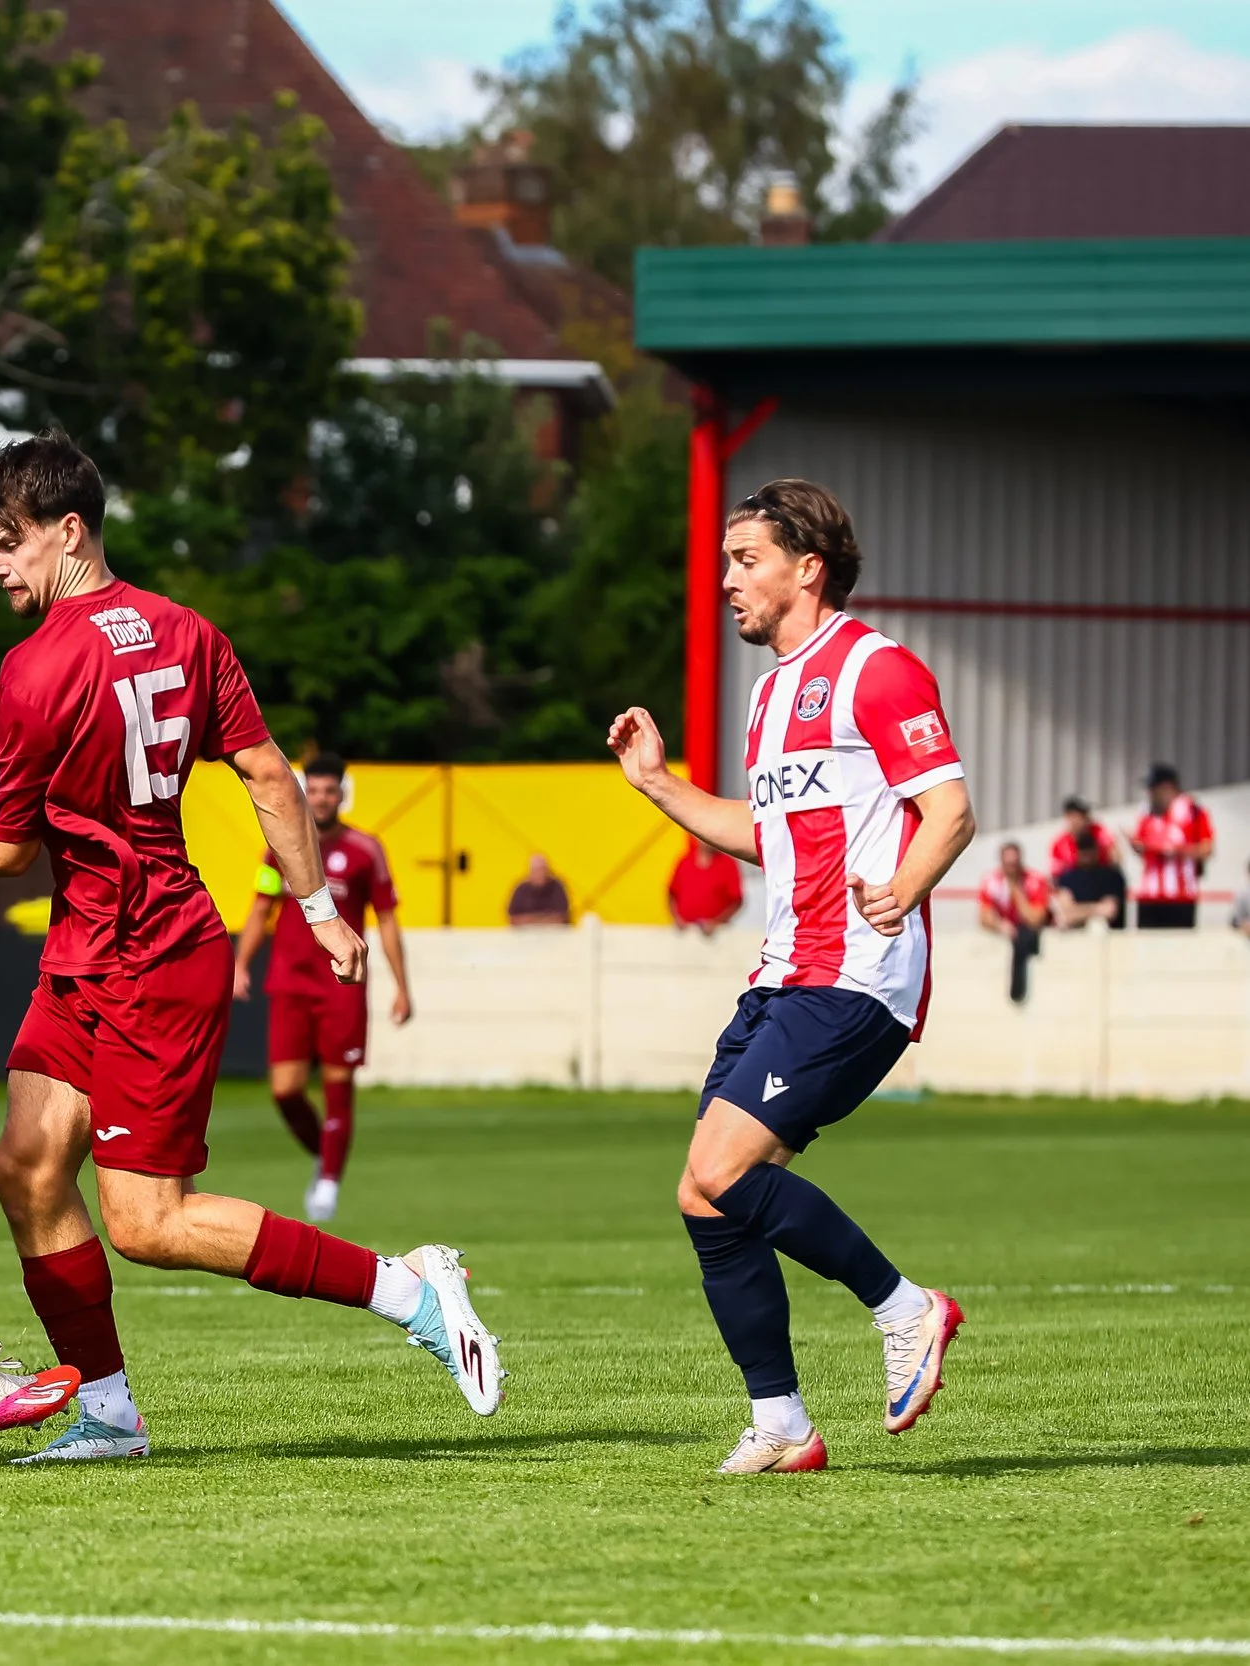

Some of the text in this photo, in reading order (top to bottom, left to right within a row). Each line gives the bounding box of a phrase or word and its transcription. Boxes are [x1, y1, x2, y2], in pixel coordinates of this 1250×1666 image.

[89, 606, 141, 627] SPORTING
[100, 618, 153, 648] TOUCH
[113, 665, 190, 806] 15
[752, 760, 831, 812] ONEX
